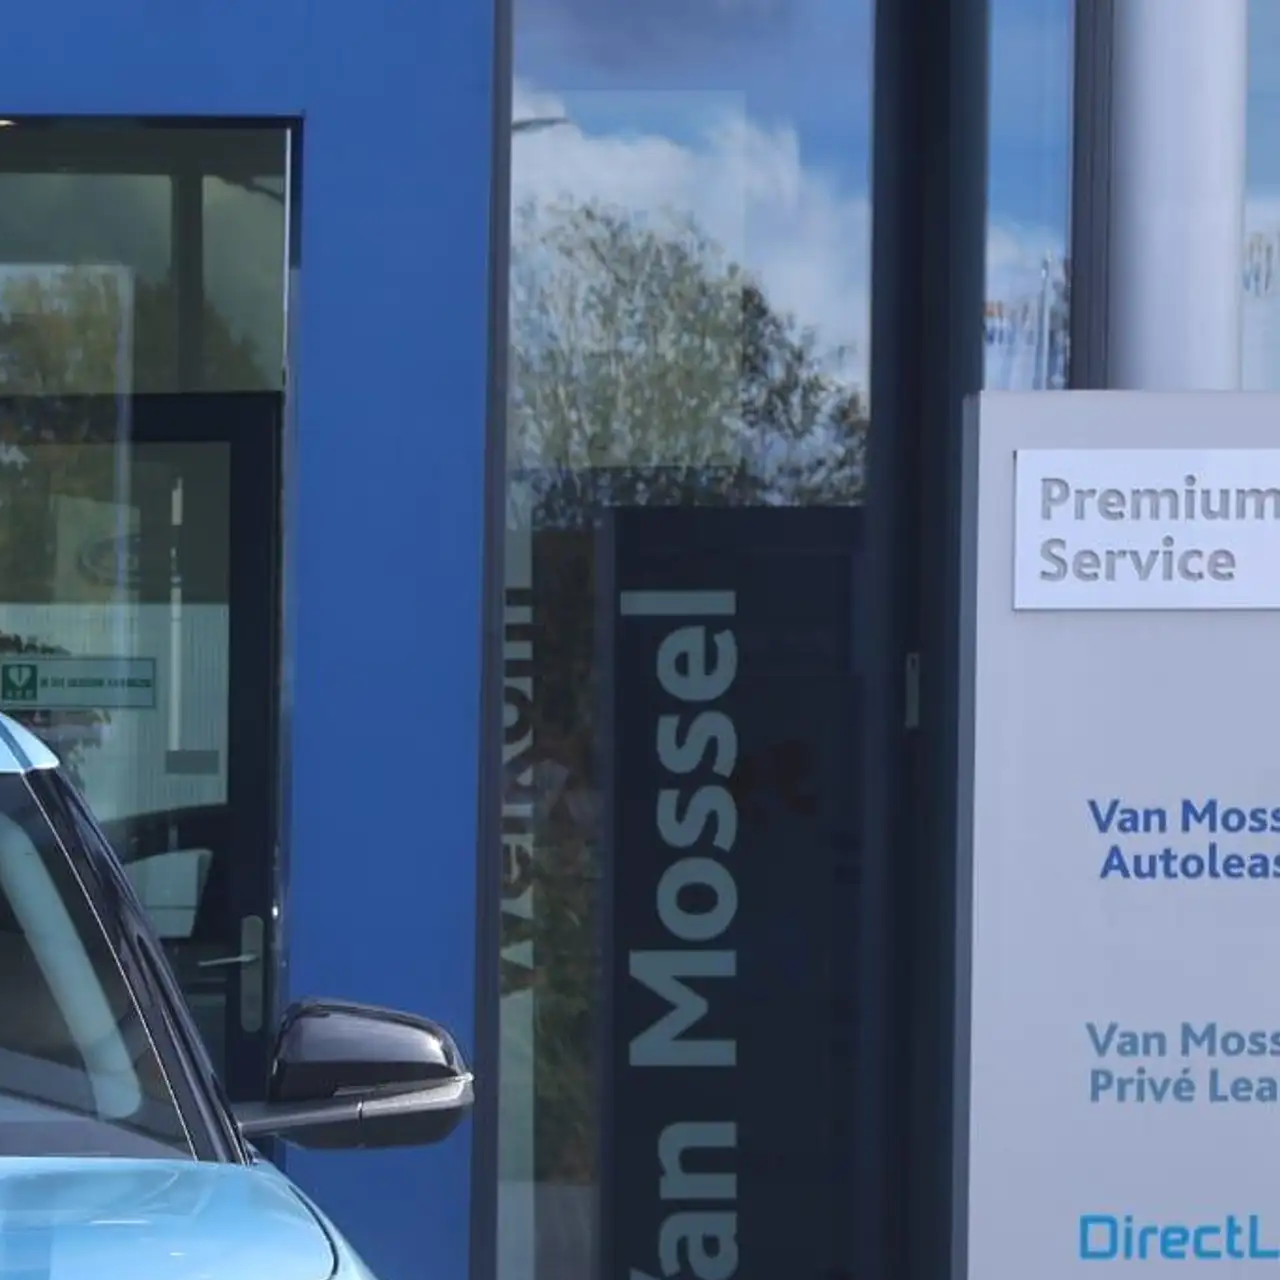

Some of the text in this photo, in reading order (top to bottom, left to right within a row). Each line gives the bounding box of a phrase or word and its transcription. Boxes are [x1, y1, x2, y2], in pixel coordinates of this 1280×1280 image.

[1040, 474, 1280, 521] Premium
[1040, 535, 1236, 582] Service
[620, 590, 738, 1066] Mossel
[1087, 798, 1167, 834] Van
[1085, 1022, 1167, 1058] Van
[1090, 1066, 1278, 1103] Privé Lea
[1079, 1214, 1280, 1260] DirectL
